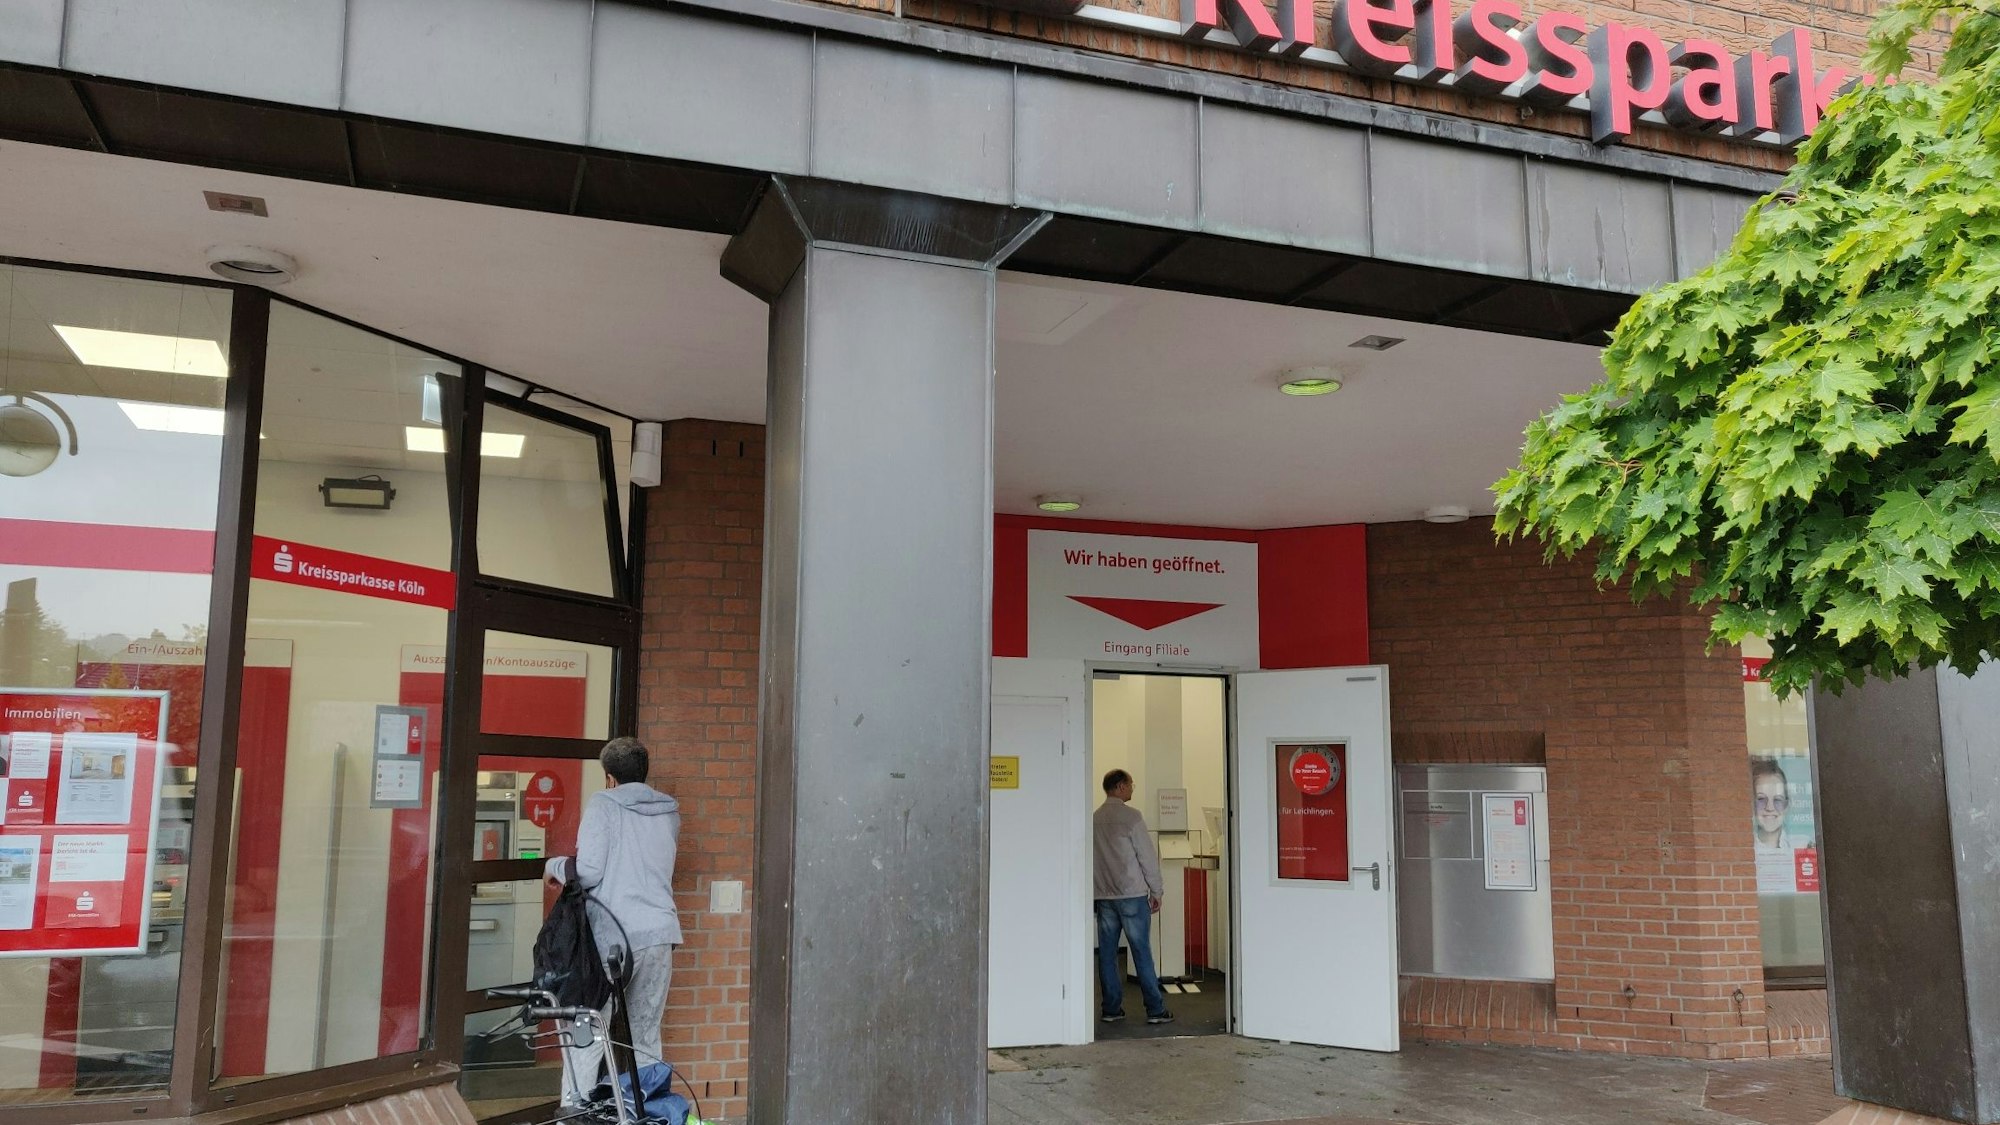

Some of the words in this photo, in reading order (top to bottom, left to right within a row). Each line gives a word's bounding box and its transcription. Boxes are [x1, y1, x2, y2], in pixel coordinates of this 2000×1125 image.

[1064, 549, 1093, 565] Wir
[1098, 551, 1147, 569] haben
[1153, 555, 1225, 574] geöffnet.
[298, 561, 395, 591] Kreissparkasse
[398, 580, 425, 597] Köln
[1104, 641, 1152, 657] Eingang
[1156, 643, 1190, 656] Filiale
[4, 707, 81, 720] Immobilien
[1282, 807, 1291, 815] für
[1294, 807, 1335, 817] Leichlingen.
